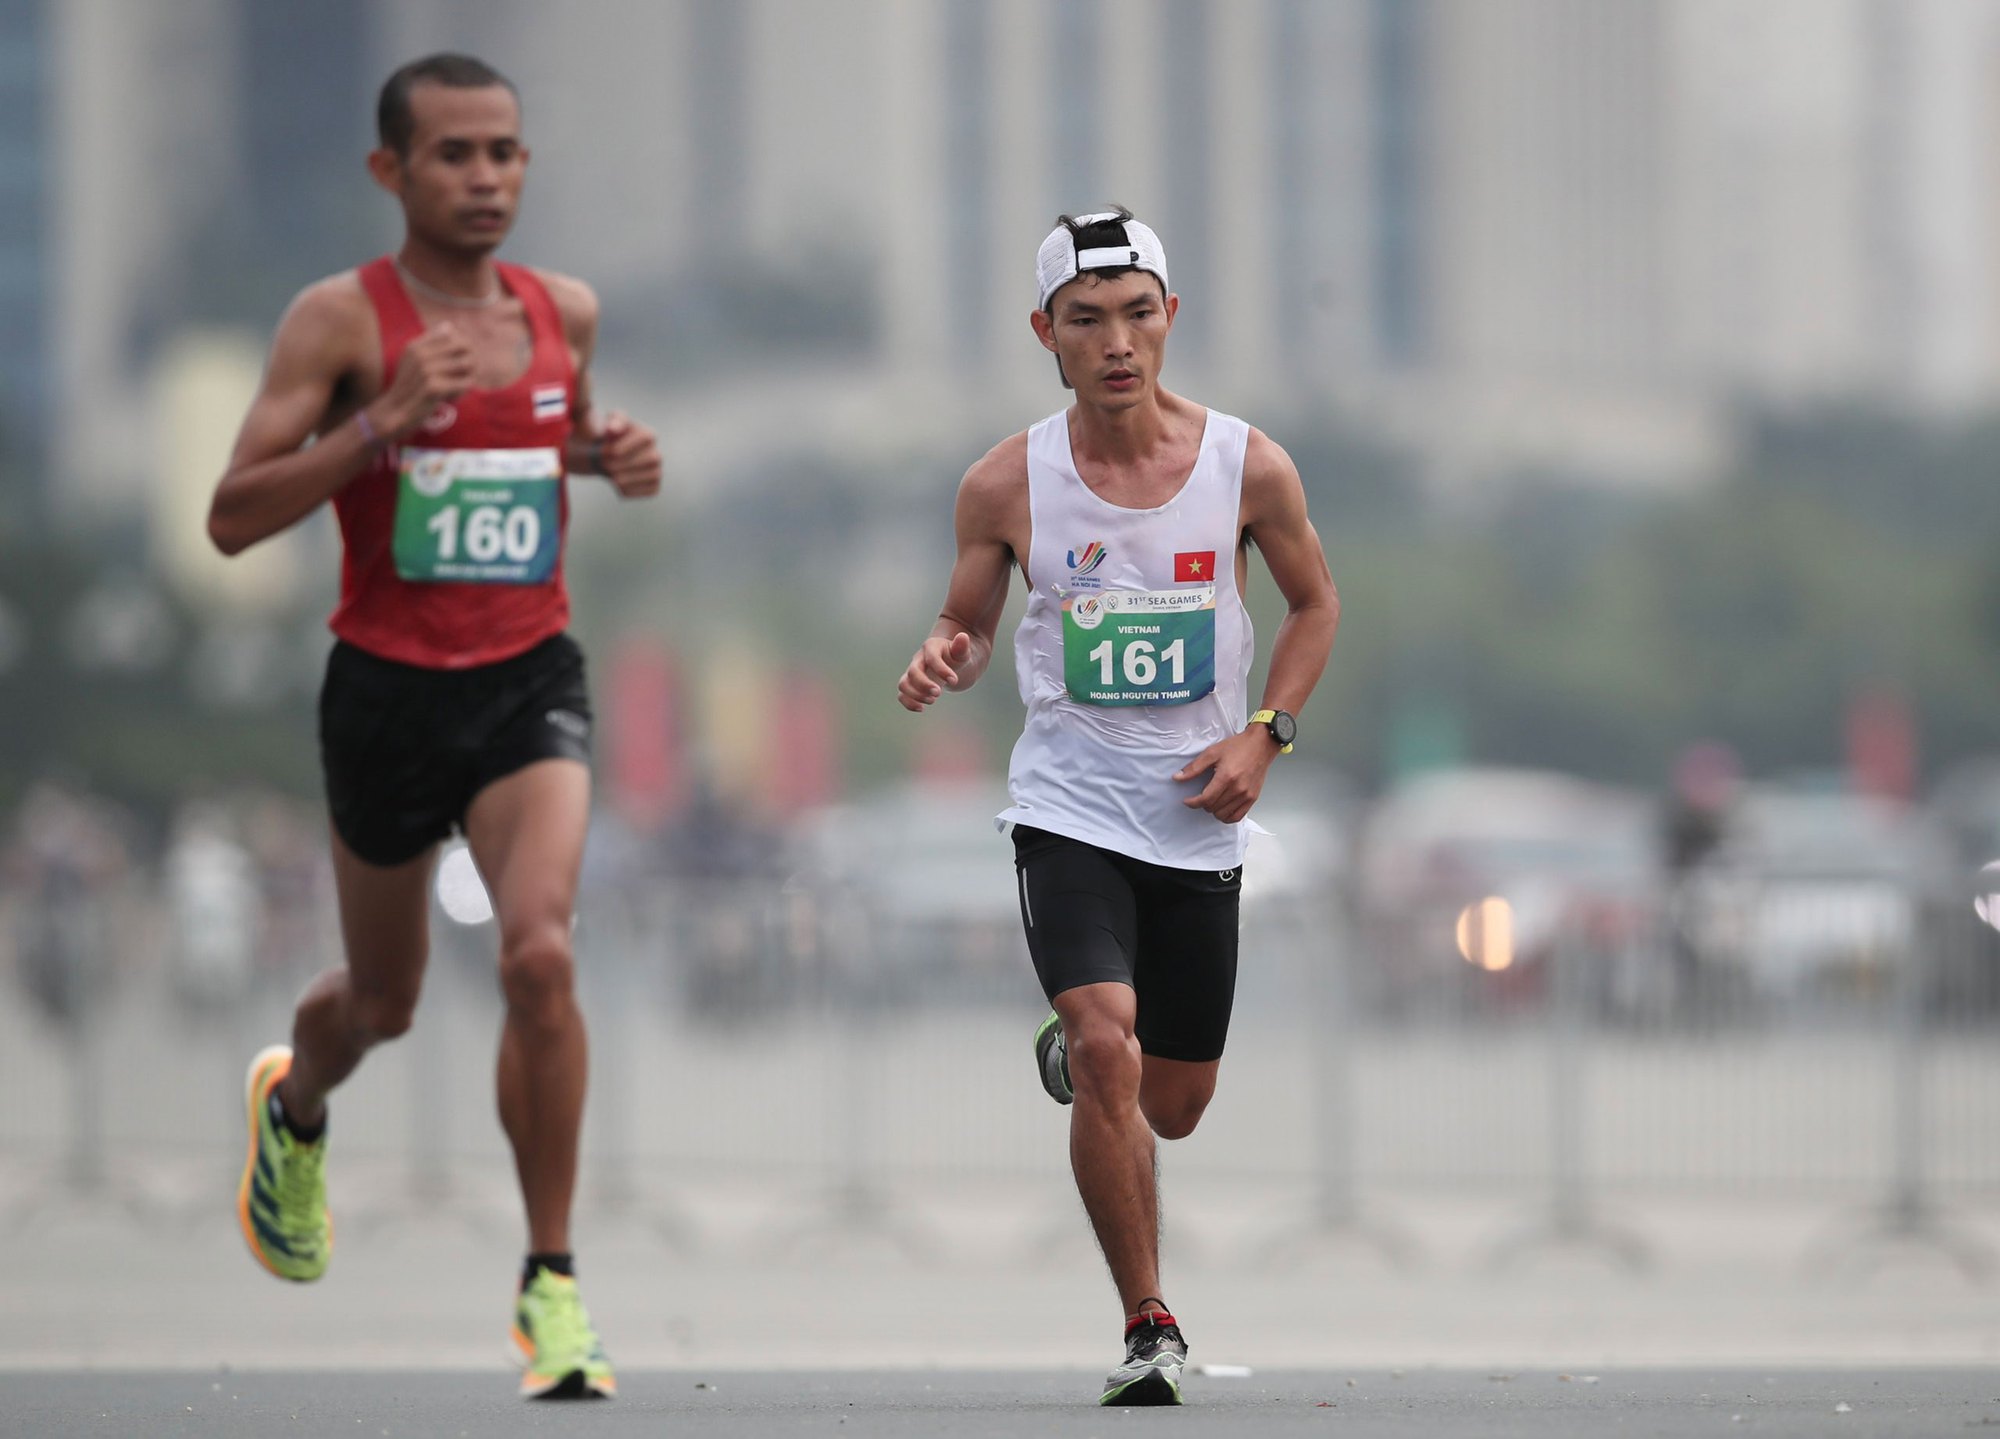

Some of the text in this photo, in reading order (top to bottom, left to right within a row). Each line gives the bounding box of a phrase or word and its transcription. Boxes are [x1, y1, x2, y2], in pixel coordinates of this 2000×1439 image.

[427, 505, 540, 562] 160
[1148, 597, 1167, 605] SEA
[1169, 594, 1202, 605] GAMES
[1118, 625, 1160, 634] VIETNAM
[1089, 639, 1185, 685] 161
[1090, 690, 1190, 700] HOANG NGUYEN THANH
